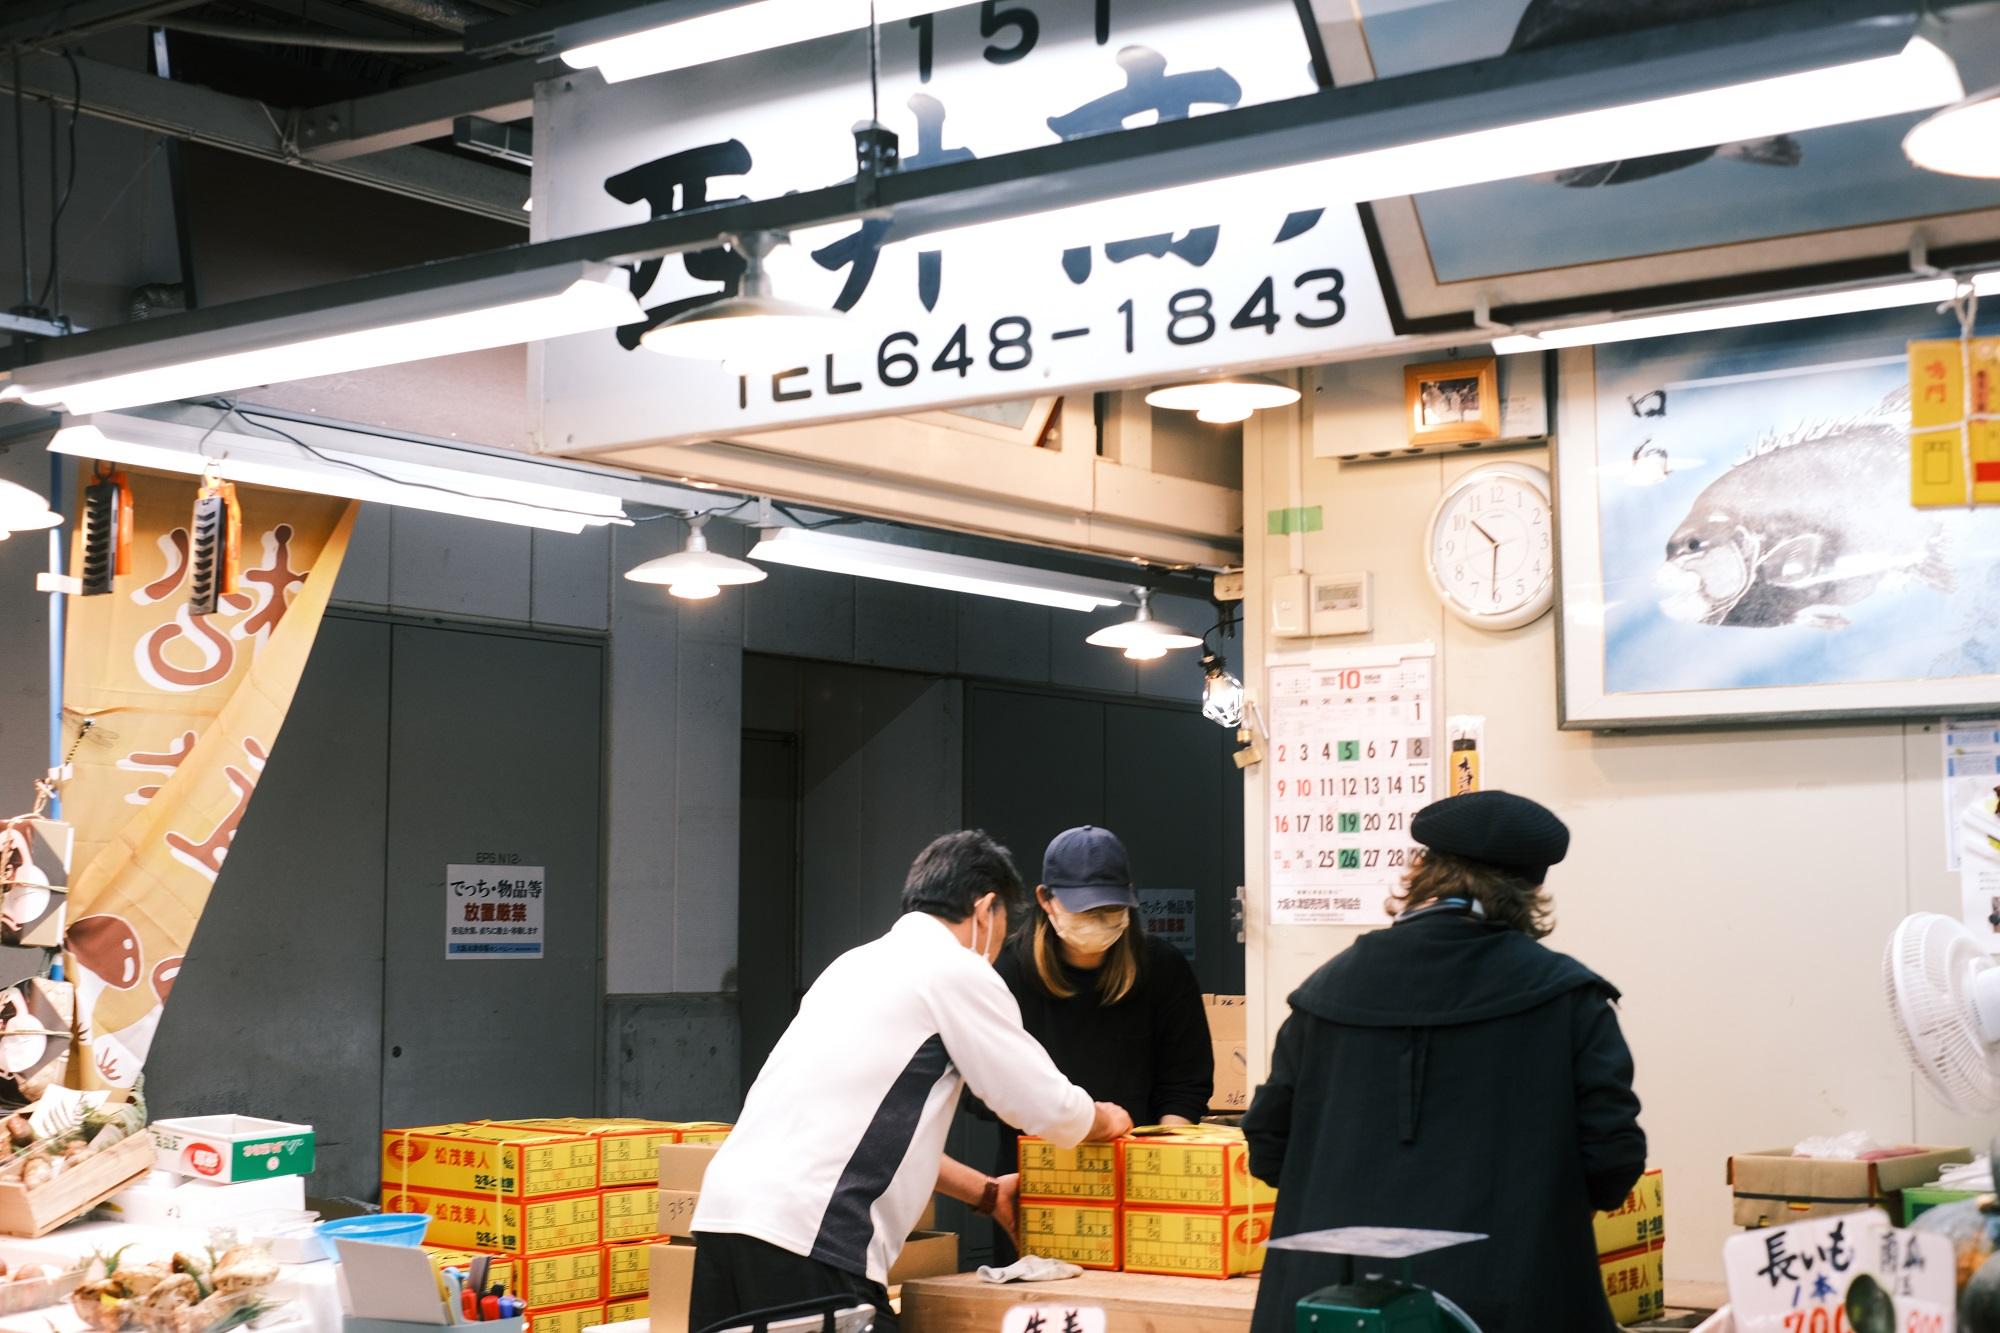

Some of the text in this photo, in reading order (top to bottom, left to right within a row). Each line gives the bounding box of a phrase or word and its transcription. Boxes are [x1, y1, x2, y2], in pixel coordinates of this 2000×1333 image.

[1532, 508, 1541, 525] 2
[1337, 671, 1361, 689] 10
[1415, 703, 1421, 720] 1
[1278, 739, 1422, 762] 2 3 4 5 6 7 8
[1277, 775, 1426, 797] 9 10 11 12 13 14 15
[1275, 813, 1402, 833] 16 17 18 19 20 21
[1319, 851, 1334, 868] 25
[1341, 850, 1357, 868] 26
[1364, 850, 1380, 868] 27
[1388, 850, 1404, 867] 28
[435, 1146, 489, 1169] 松茂美人
[1607, 1188, 1647, 1219] 美人
[1757, 1221, 1852, 1287] 長いも
